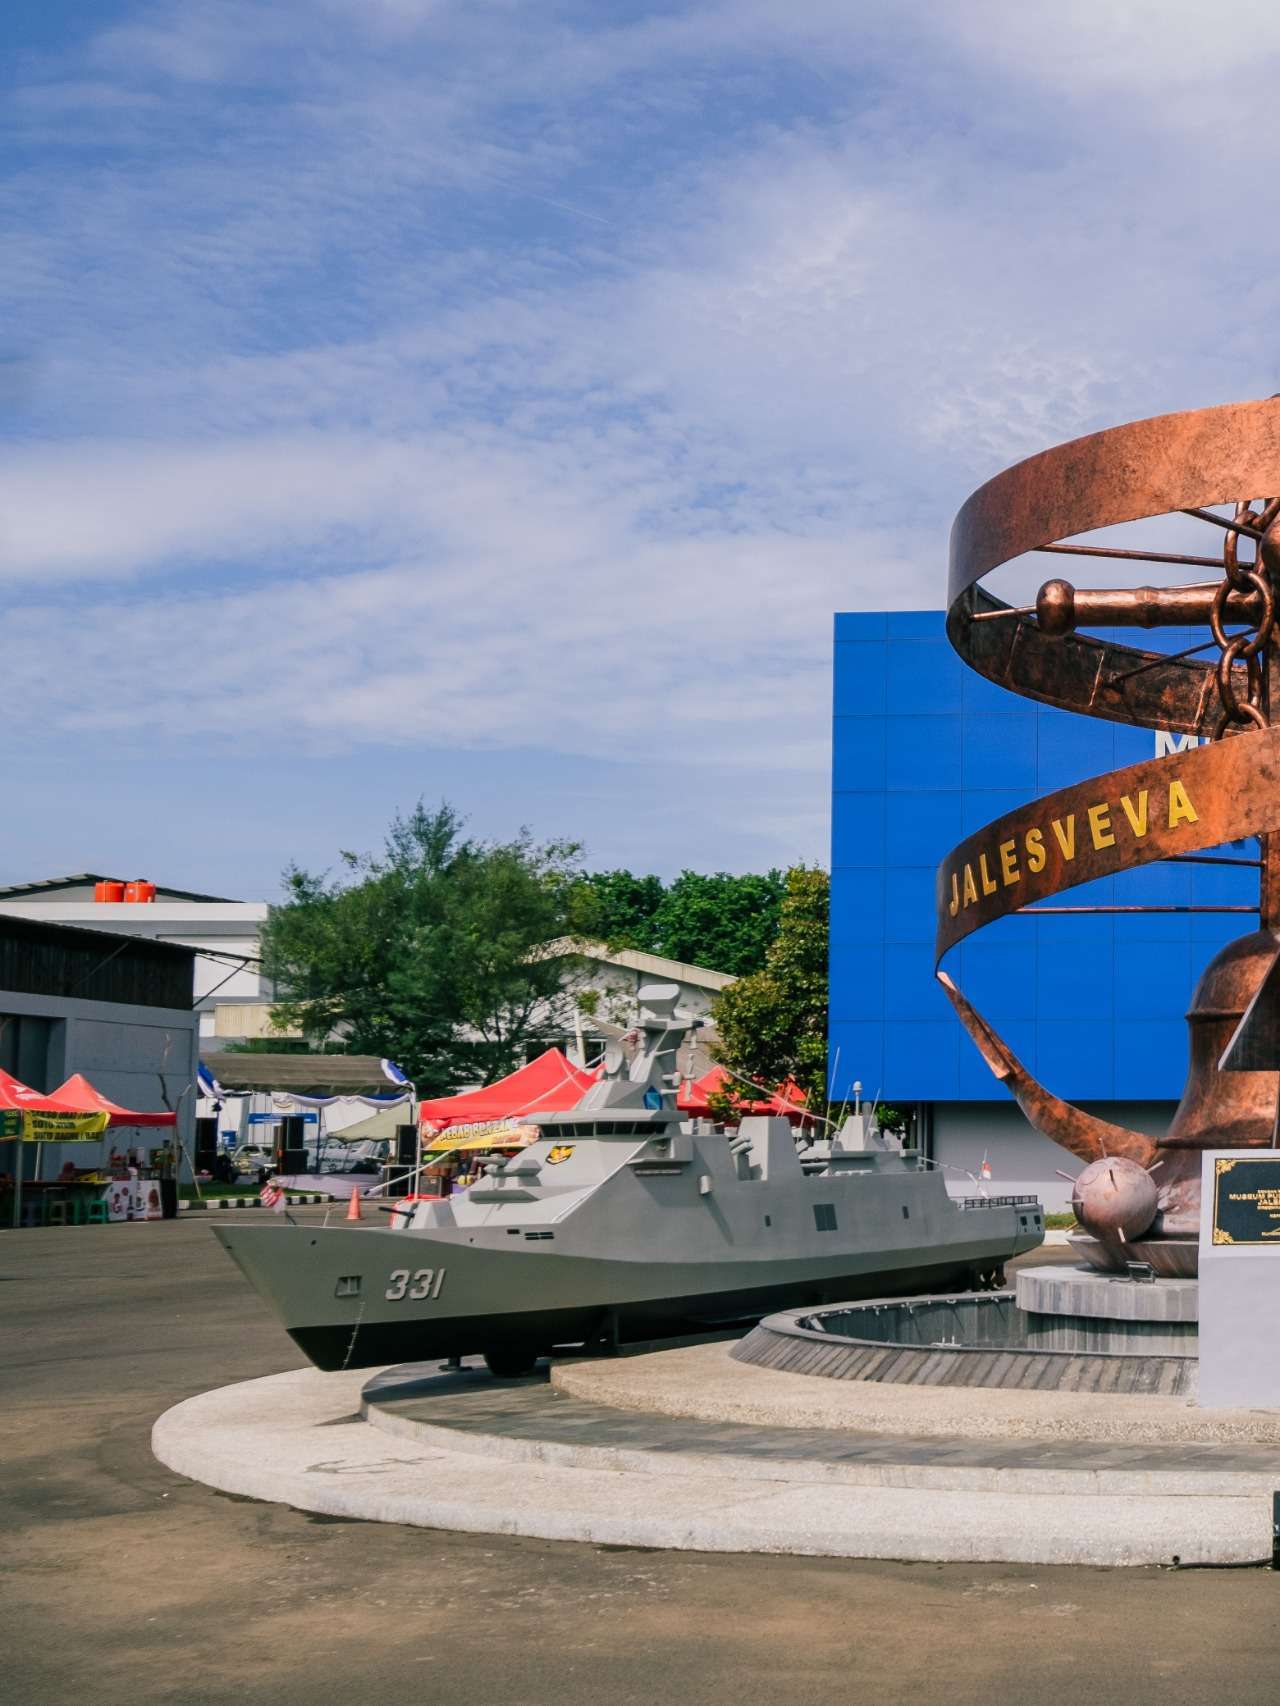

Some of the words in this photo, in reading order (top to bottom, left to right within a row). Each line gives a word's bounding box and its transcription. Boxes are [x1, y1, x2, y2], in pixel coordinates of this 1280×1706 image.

[949, 780, 1199, 918] JALESVEVA
[1229, 1192, 1266, 1201] MUSEUM
[384, 1268, 446, 1301] 331
